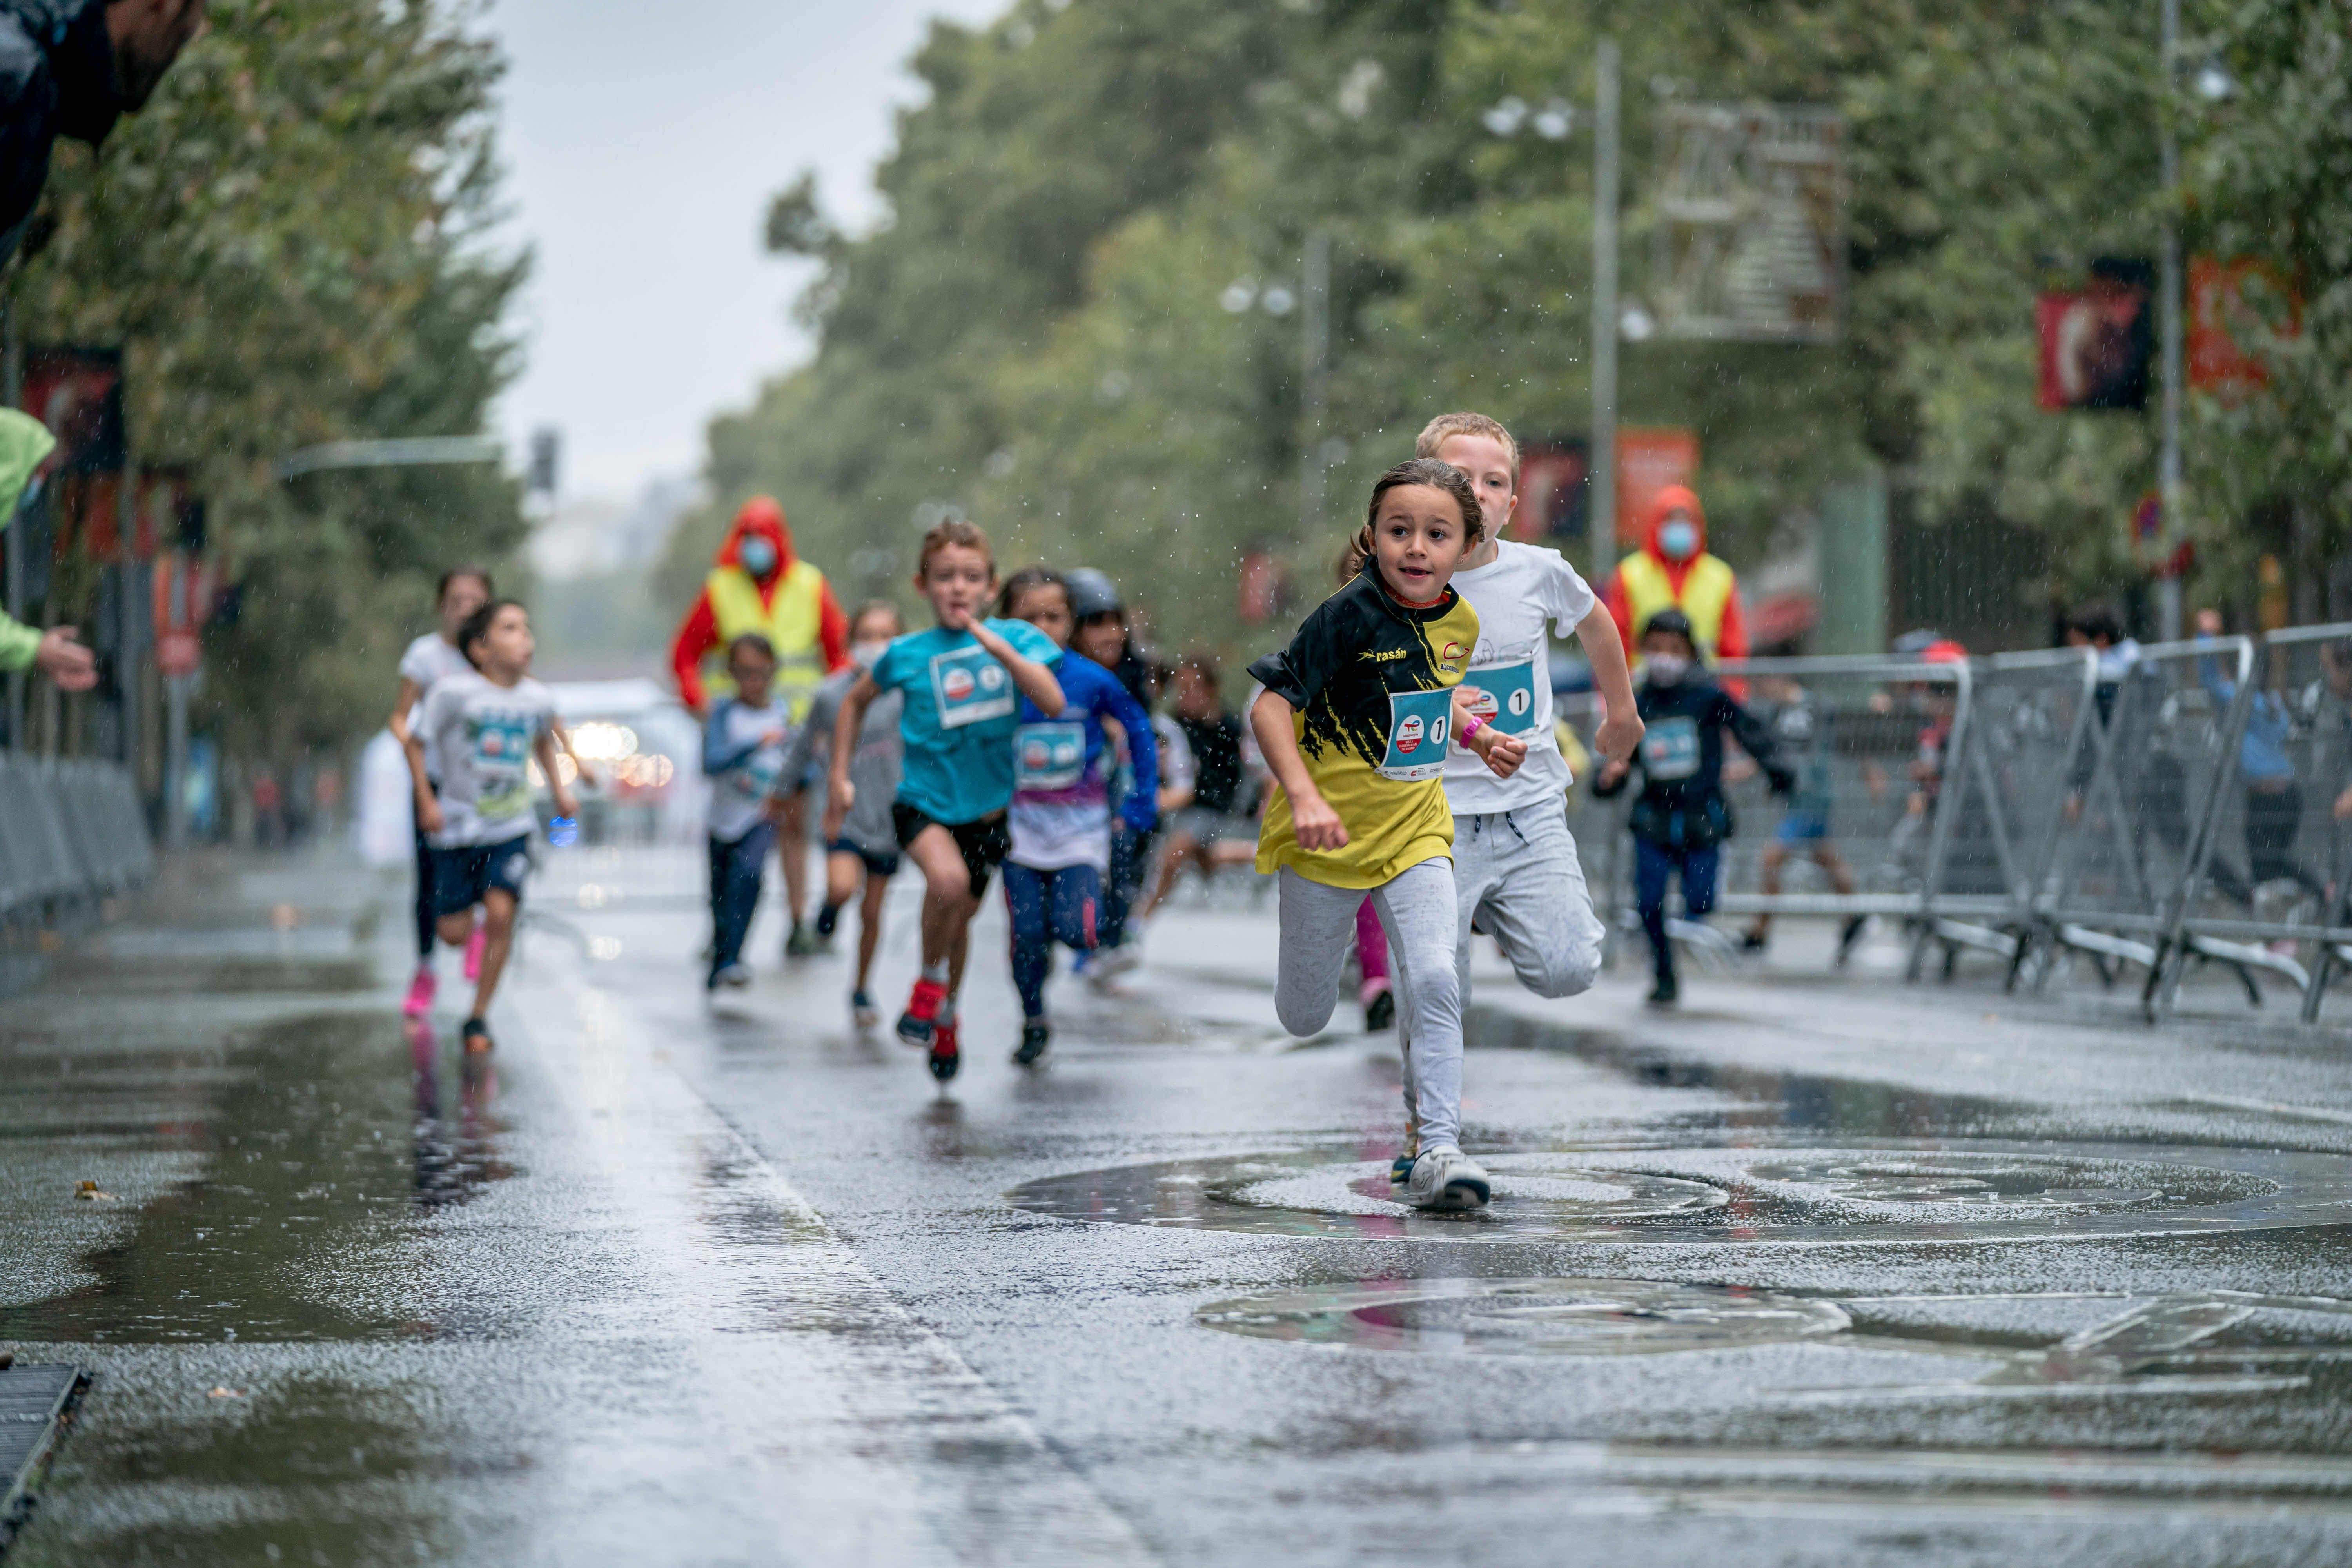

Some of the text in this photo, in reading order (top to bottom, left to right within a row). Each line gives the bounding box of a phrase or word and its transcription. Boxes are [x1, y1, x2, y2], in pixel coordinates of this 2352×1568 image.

[1377, 647, 1406, 662] rasán
[1515, 692, 1522, 711] 1
[1437, 720, 1443, 740] 1
